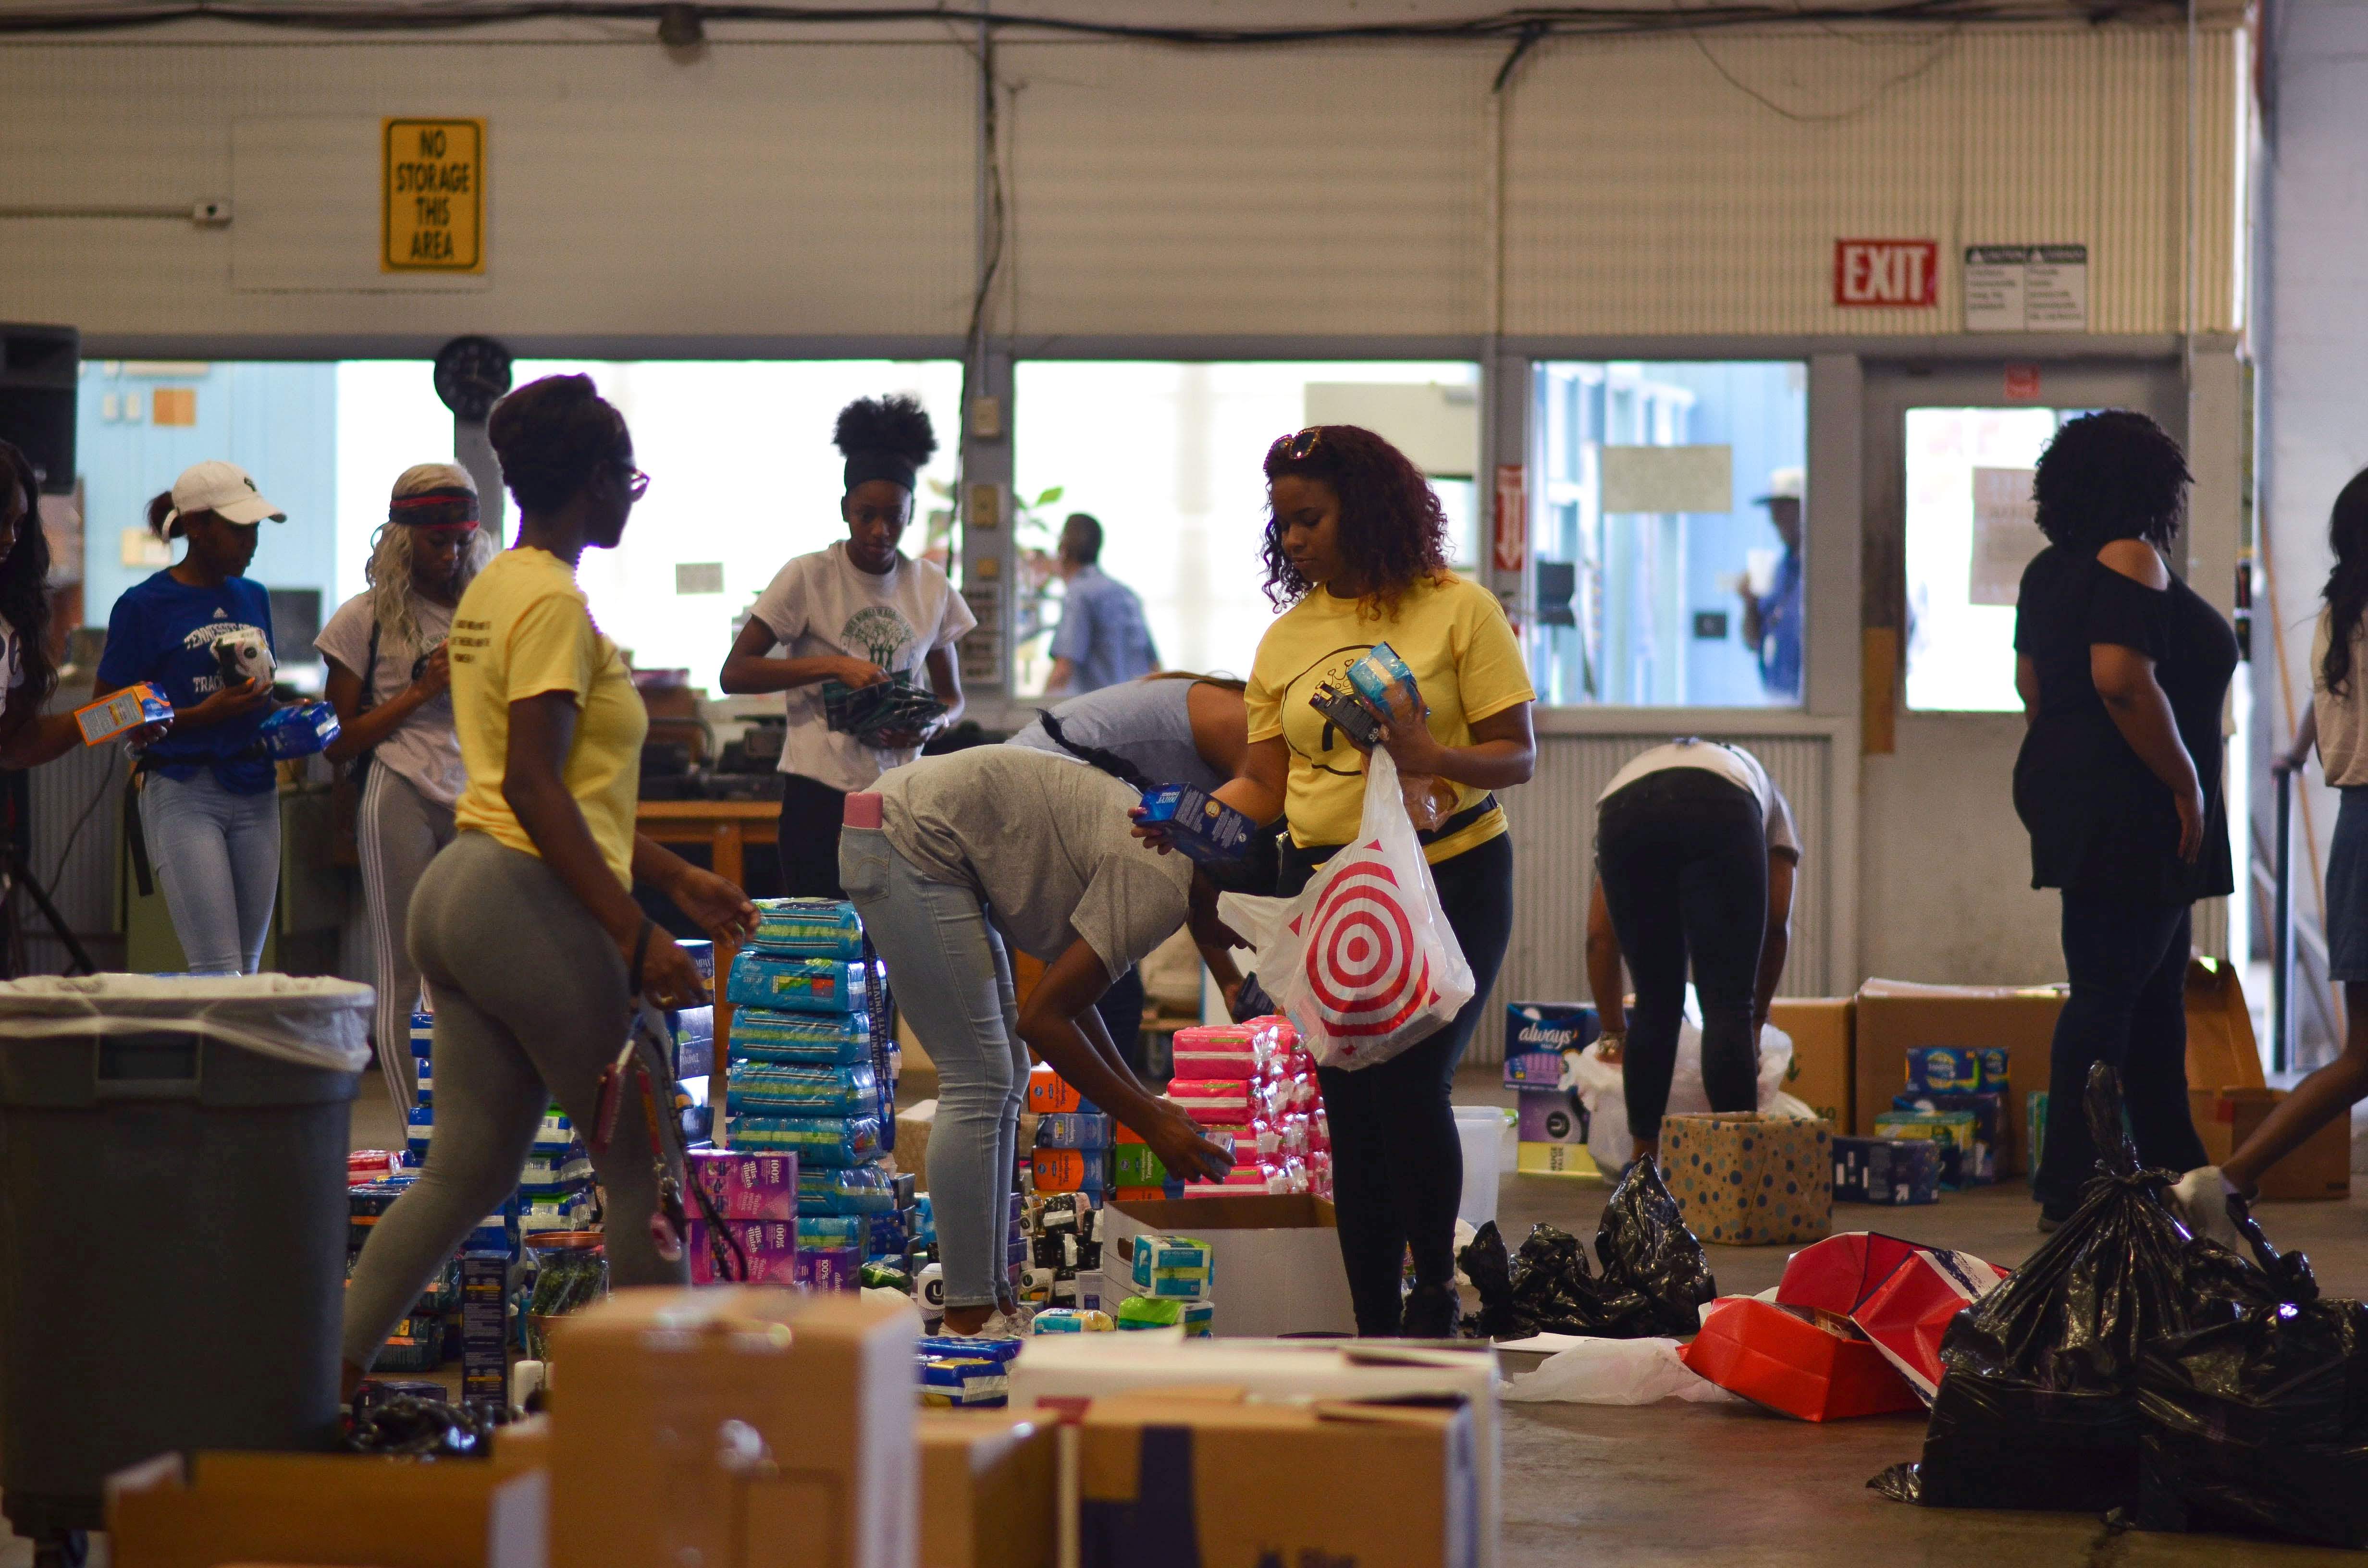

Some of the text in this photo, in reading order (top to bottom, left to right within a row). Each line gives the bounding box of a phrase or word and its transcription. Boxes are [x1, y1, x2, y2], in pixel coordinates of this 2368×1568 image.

[419, 130, 446, 159] NO
[396, 162, 469, 194] STORAGE
[416, 196, 450, 226] THIS
[411, 231, 454, 259] AREA
[1842, 244, 1928, 301] EXIT
[1518, 1022, 1572, 1050] always
[742, 1162, 753, 1188] Match
[749, 1161, 757, 1179] Mix
[771, 1159, 779, 1183] 100%
[747, 1226, 758, 1253] Match
[754, 1225, 762, 1244] Mix
[776, 1224, 784, 1248] 100%
